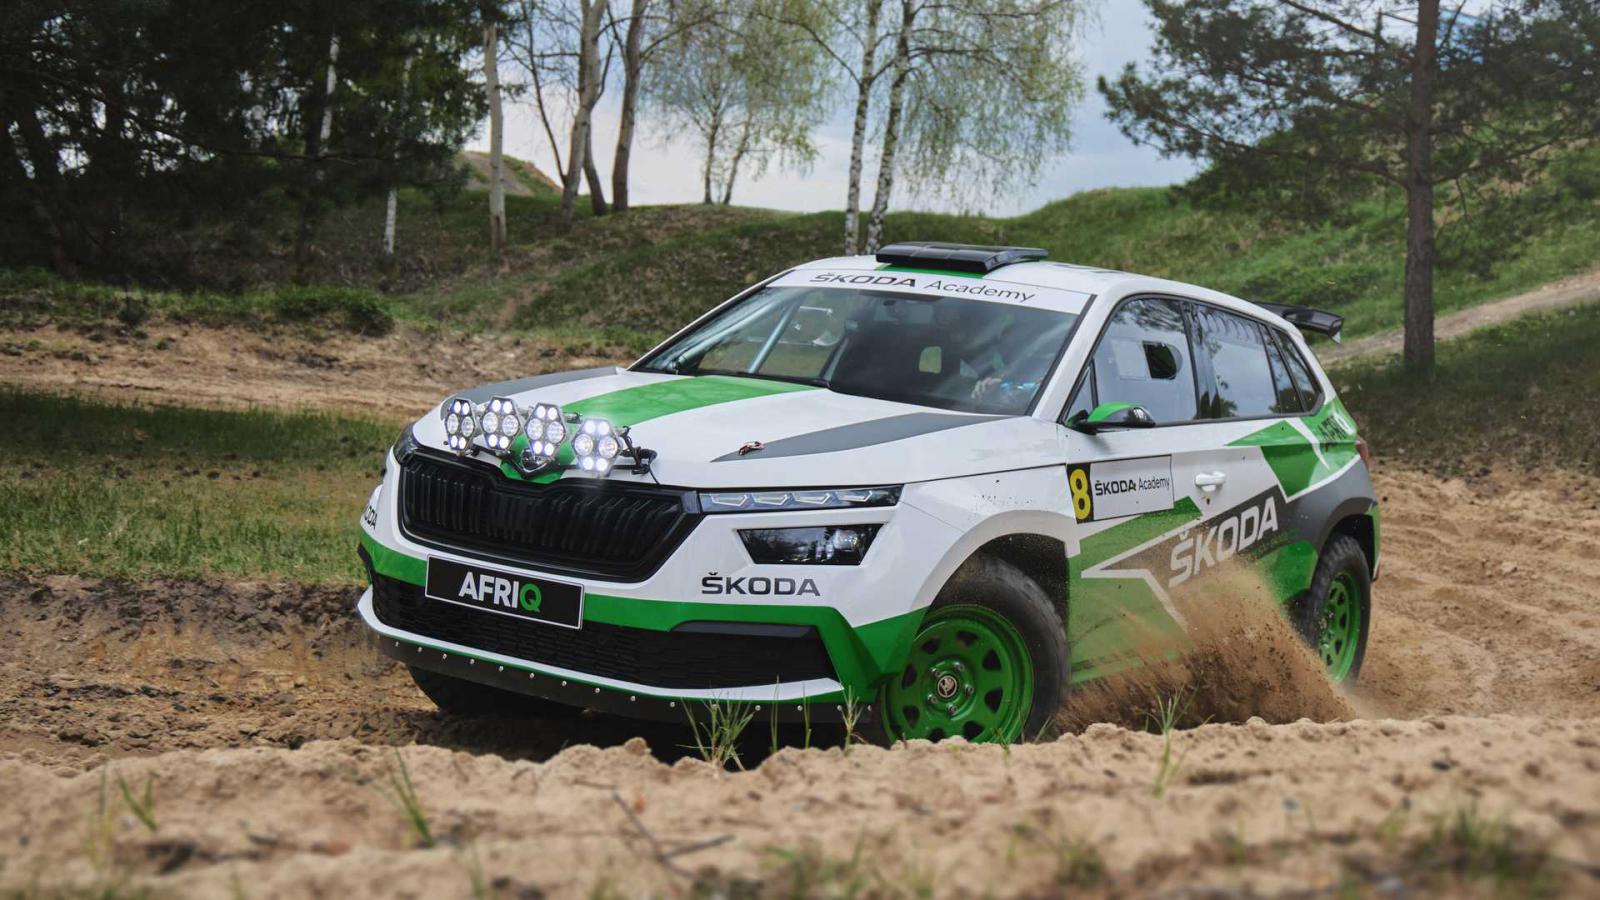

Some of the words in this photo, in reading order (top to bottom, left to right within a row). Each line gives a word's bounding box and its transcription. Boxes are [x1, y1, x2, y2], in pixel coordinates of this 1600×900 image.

[809, 272, 916, 287] ŠKODA
[923, 279, 1036, 303] Academy
[1069, 468, 1091, 521] 8
[1094, 480, 1137, 497] ŠKODA
[1138, 476, 1170, 491] Academy
[1168, 496, 1279, 588] ŠKODA
[457, 570, 542, 613] AFRIQ
[700, 572, 821, 597] ŠKODA
